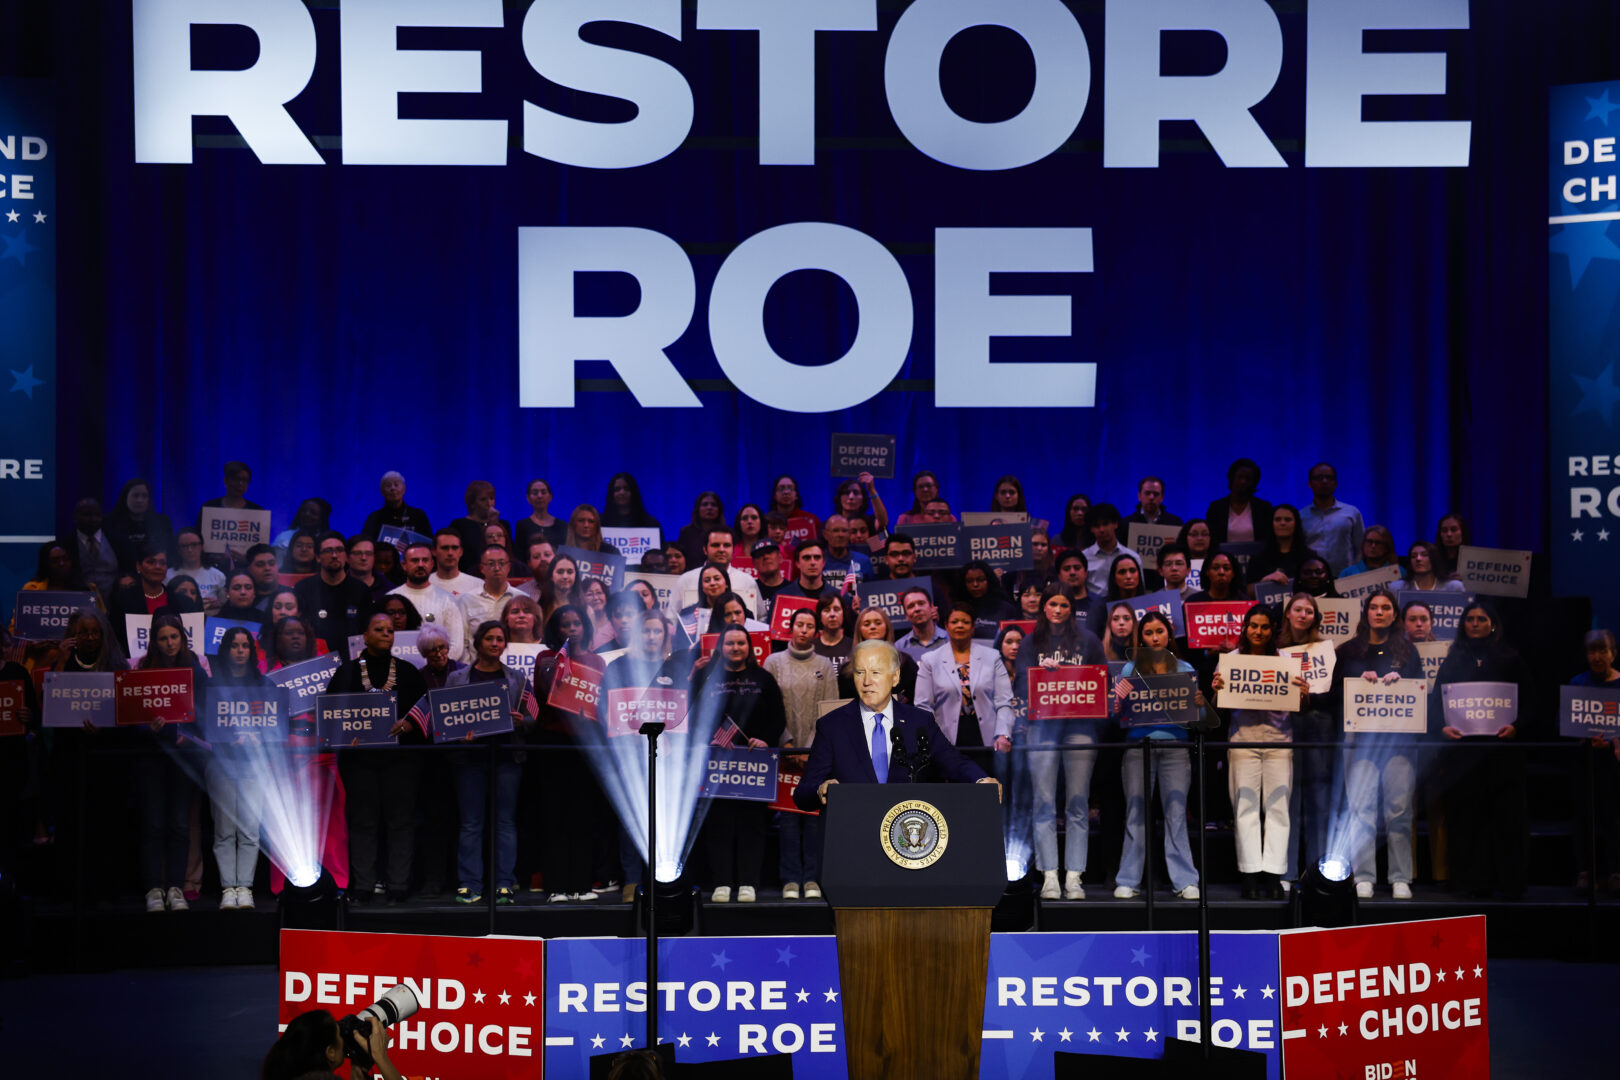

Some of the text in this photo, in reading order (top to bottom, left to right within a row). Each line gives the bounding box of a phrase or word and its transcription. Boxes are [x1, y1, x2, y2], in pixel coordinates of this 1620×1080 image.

[132, 0, 1472, 171] RESTORE
[518, 221, 1097, 413] ROE
[839, 446, 888, 456] DEFEND
[840, 457, 886, 467] CHOICE
[211, 520, 260, 532] BIDEN
[210, 532, 260, 543] HARRIS
[914, 535, 957, 546] EFEND
[970, 536, 1023, 550] BIDEN
[915, 546, 955, 557] HOICE
[971, 548, 1023, 560] HARRIS
[576, 560, 615, 577] IDEN
[1467, 561, 1522, 573] DEFEND
[1467, 572, 1518, 584] CHOICE
[41, 618, 70, 627] ROE
[506, 655, 536, 665] BID
[1230, 669, 1289, 683] BIDEN
[52, 688, 115, 698] RESTOR
[123, 684, 188, 697] RESTORE
[297, 683, 326, 698] ROE
[1037, 681, 1098, 692] DEFEND
[1229, 683, 1289, 696] HARRIS
[1040, 694, 1096, 705] CHOICE
[1129, 687, 1190, 700] DEFEND
[1354, 694, 1416, 705] DEFEND
[71, 701, 101, 711] ROE
[143, 697, 172, 708] ROE
[217, 701, 278, 715] BIDEN
[440, 696, 501, 714] DEFEND
[617, 700, 678, 711] DEFEND
[1131, 700, 1188, 713] CHOICE
[1448, 697, 1512, 709] RESTORE
[1571, 699, 1620, 714] BIDE
[323, 707, 390, 720] RESTORE
[443, 709, 501, 727] CHOICE
[620, 711, 675, 722] CHOICE
[1357, 707, 1414, 718] CHOICE
[1465, 710, 1496, 720] ROE
[217, 715, 278, 727] HARRIS
[343, 720, 373, 731] ROE
[708, 760, 769, 773] DEFEND
[709, 773, 766, 787] CHOICE
[883, 802, 913, 833] PRESIDENT
[931, 811, 947, 840] UNITED
[890, 853, 909, 866] SEAL
[919, 846, 944, 866] STATES
[997, 976, 1224, 1007] RESTORE
[1286, 962, 1431, 1009] DEFEND
[558, 980, 787, 1013] RESTORE
[1359, 998, 1482, 1041] CHOICE
[739, 1022, 837, 1054] ROE
[1365, 1059, 1417, 1080] BIDEN
